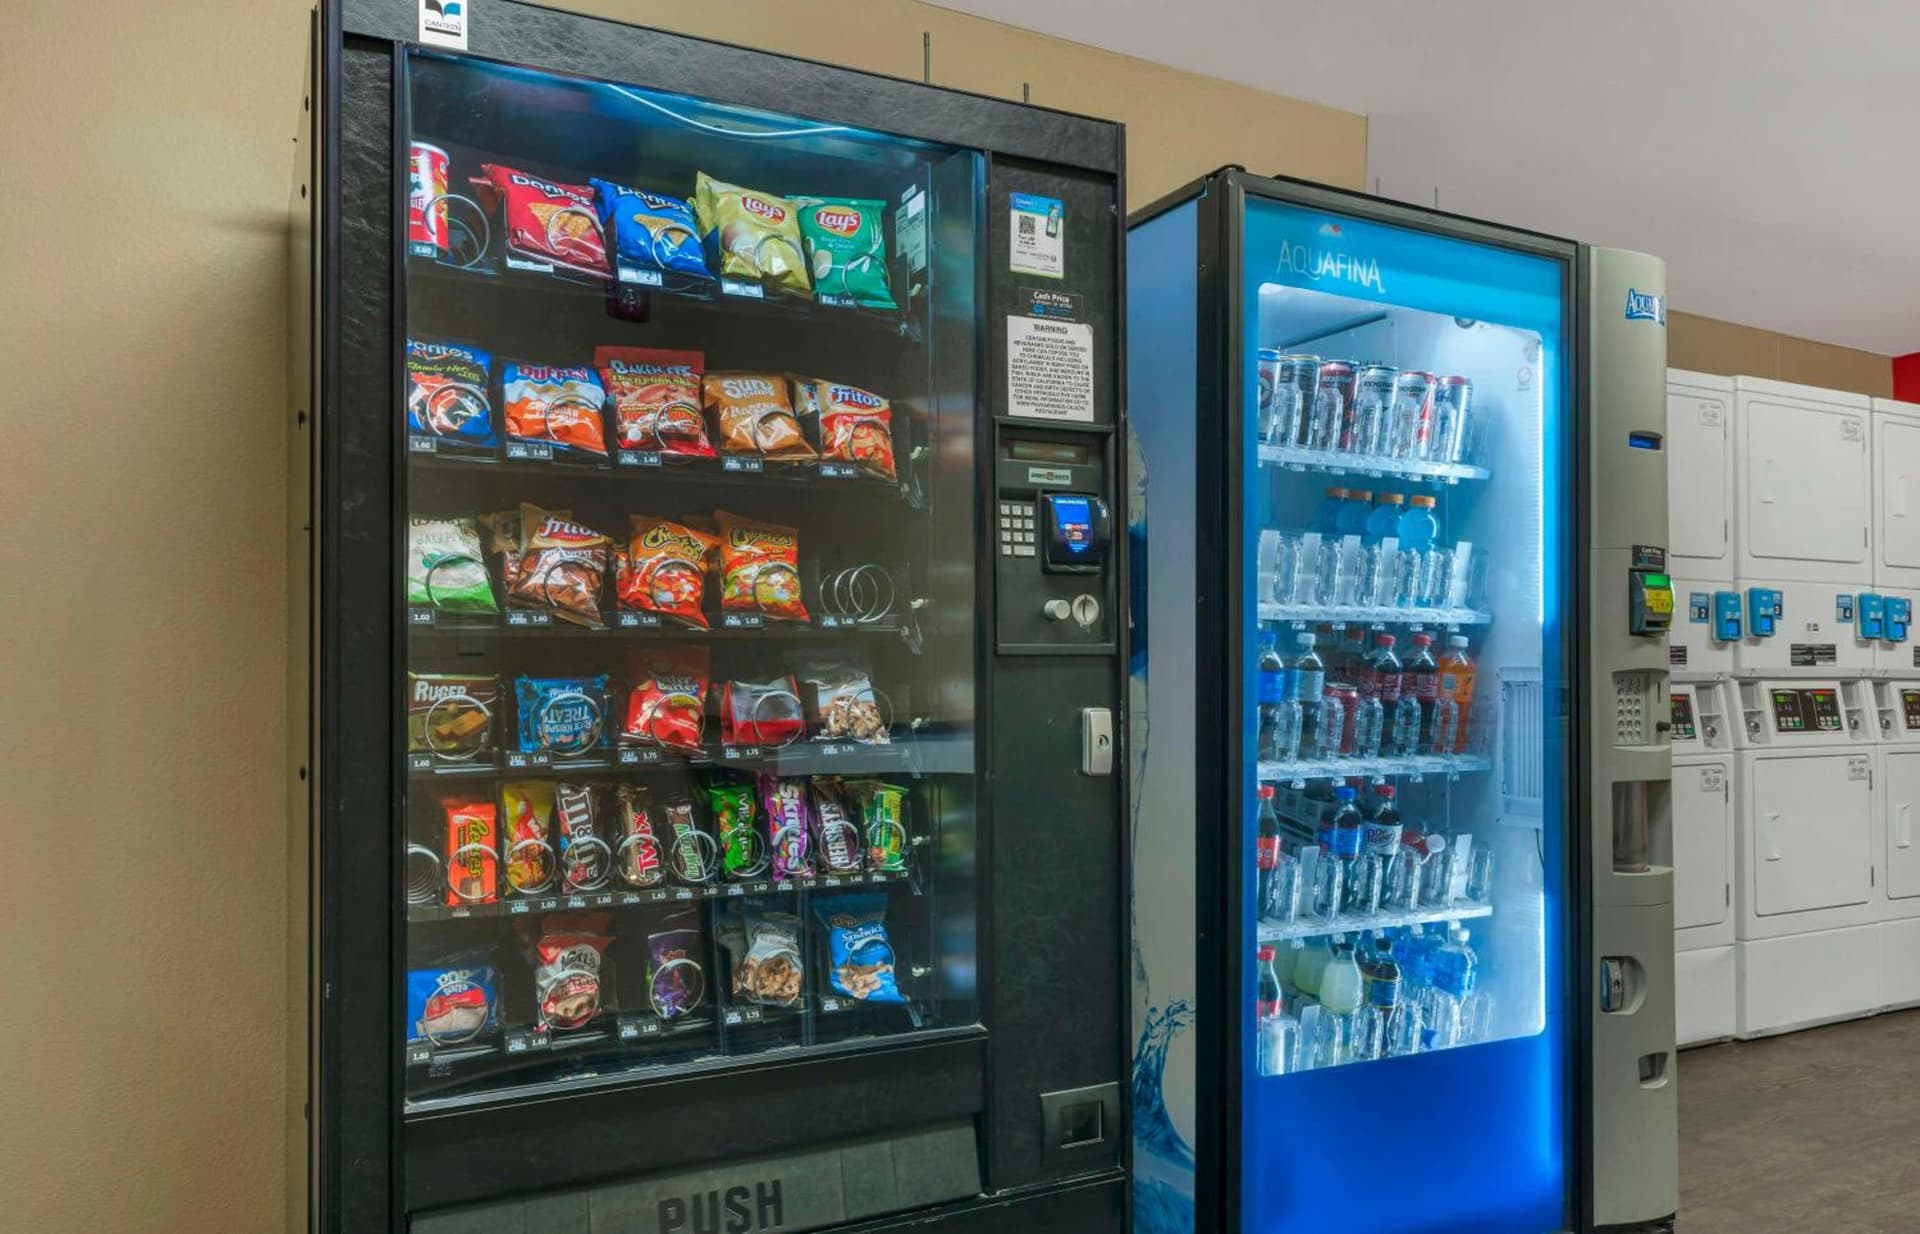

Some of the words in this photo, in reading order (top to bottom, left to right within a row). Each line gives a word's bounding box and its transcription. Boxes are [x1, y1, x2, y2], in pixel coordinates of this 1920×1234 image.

[511, 174, 591, 204] Doritos
[617, 184, 691, 213] Doritos
[743, 196, 785, 220] Lay's
[818, 211, 858, 232] Lay's
[1277, 239, 1386, 294] AQUAFINA
[832, 387, 881, 407] Fritos
[414, 680, 467, 702] RUGER
[414, 760, 431, 768] 1.60
[780, 784, 801, 870] Skittles
[841, 925, 885, 942] Sandwich
[658, 1179, 784, 1234] PUSH
